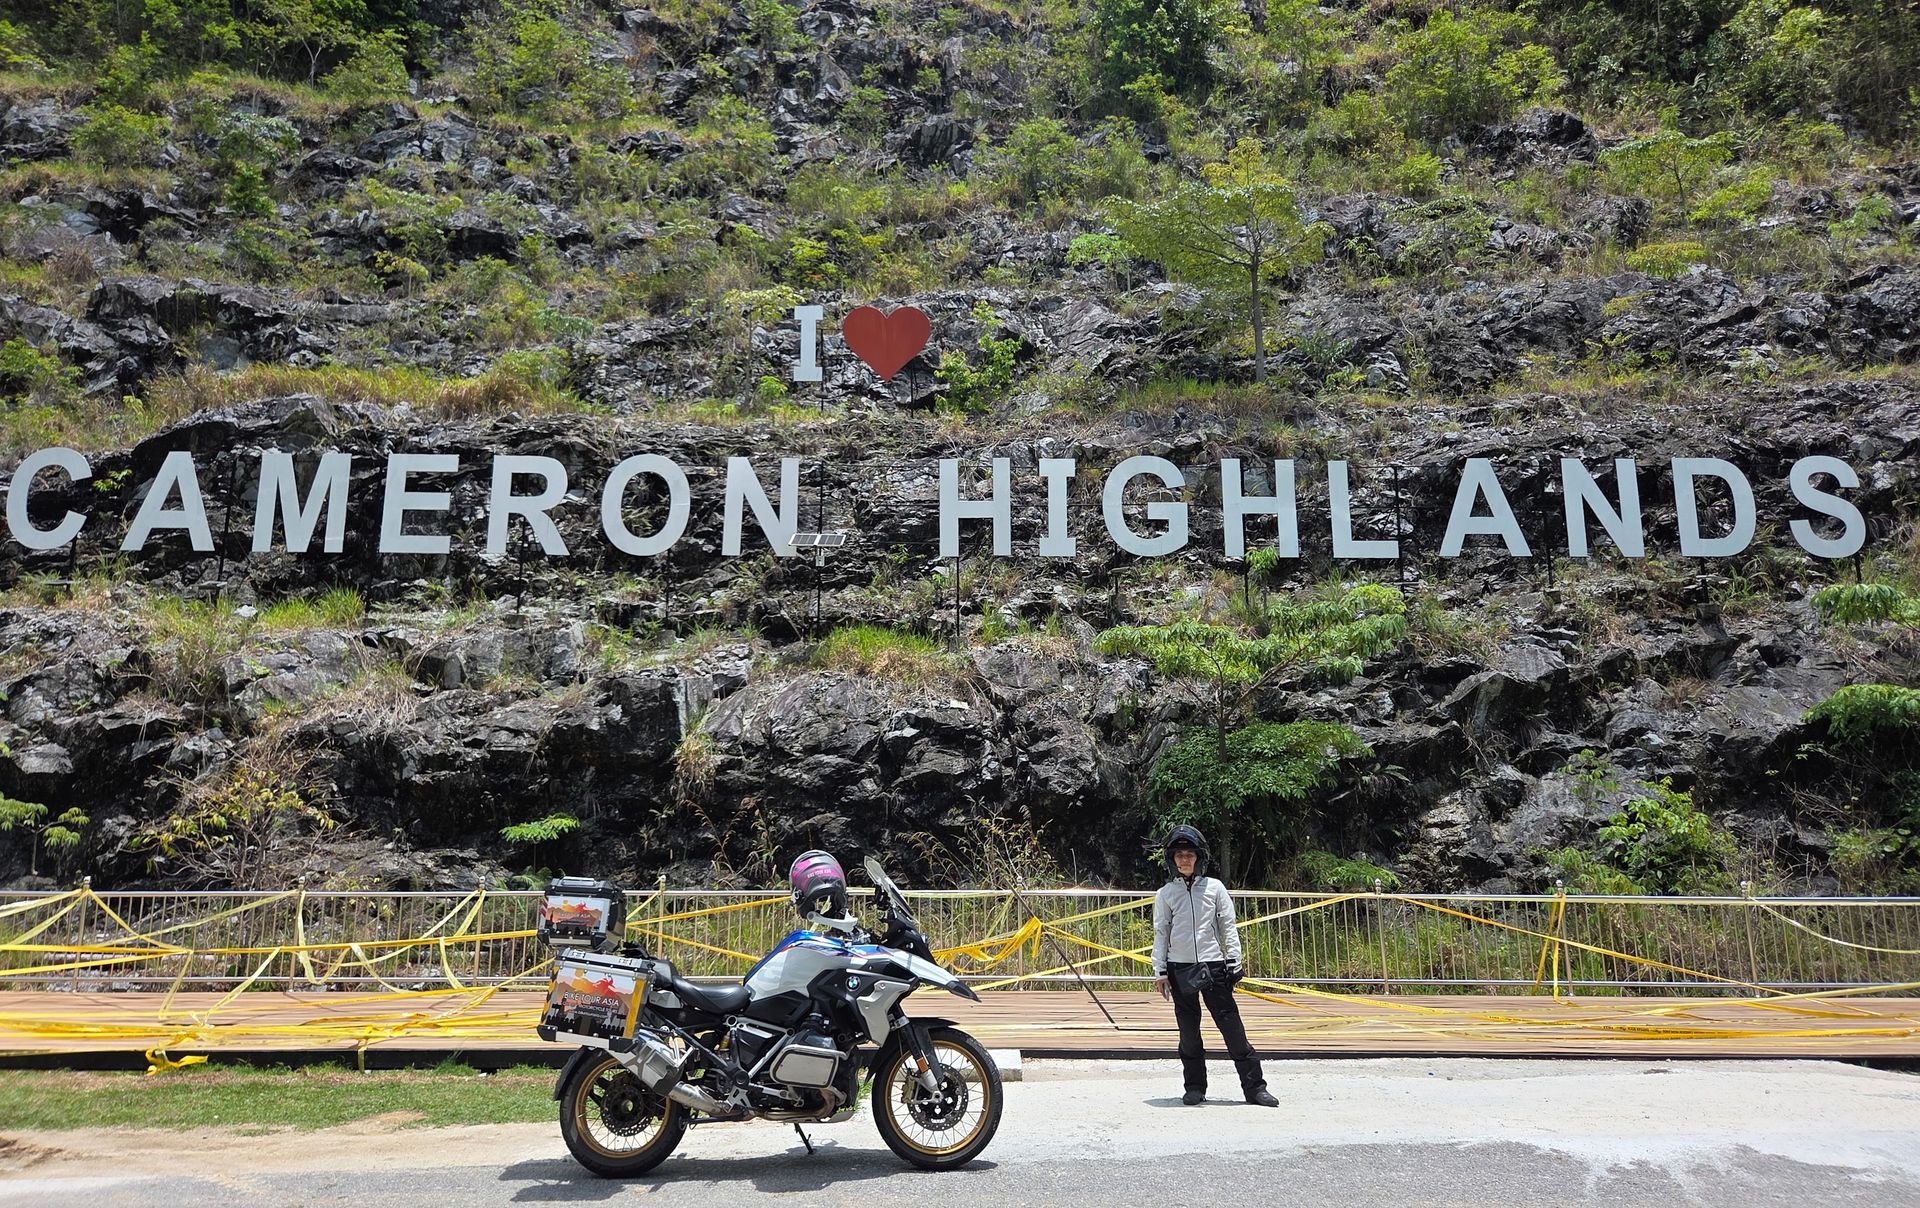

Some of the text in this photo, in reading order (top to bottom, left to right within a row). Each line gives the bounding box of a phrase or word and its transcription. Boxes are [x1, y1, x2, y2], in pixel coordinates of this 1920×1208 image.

[793, 305, 823, 382] I
[6, 446, 1867, 559] CAMERON HIGHLANDS
[564, 992, 619, 1006] BIKE TOUR ASIA
